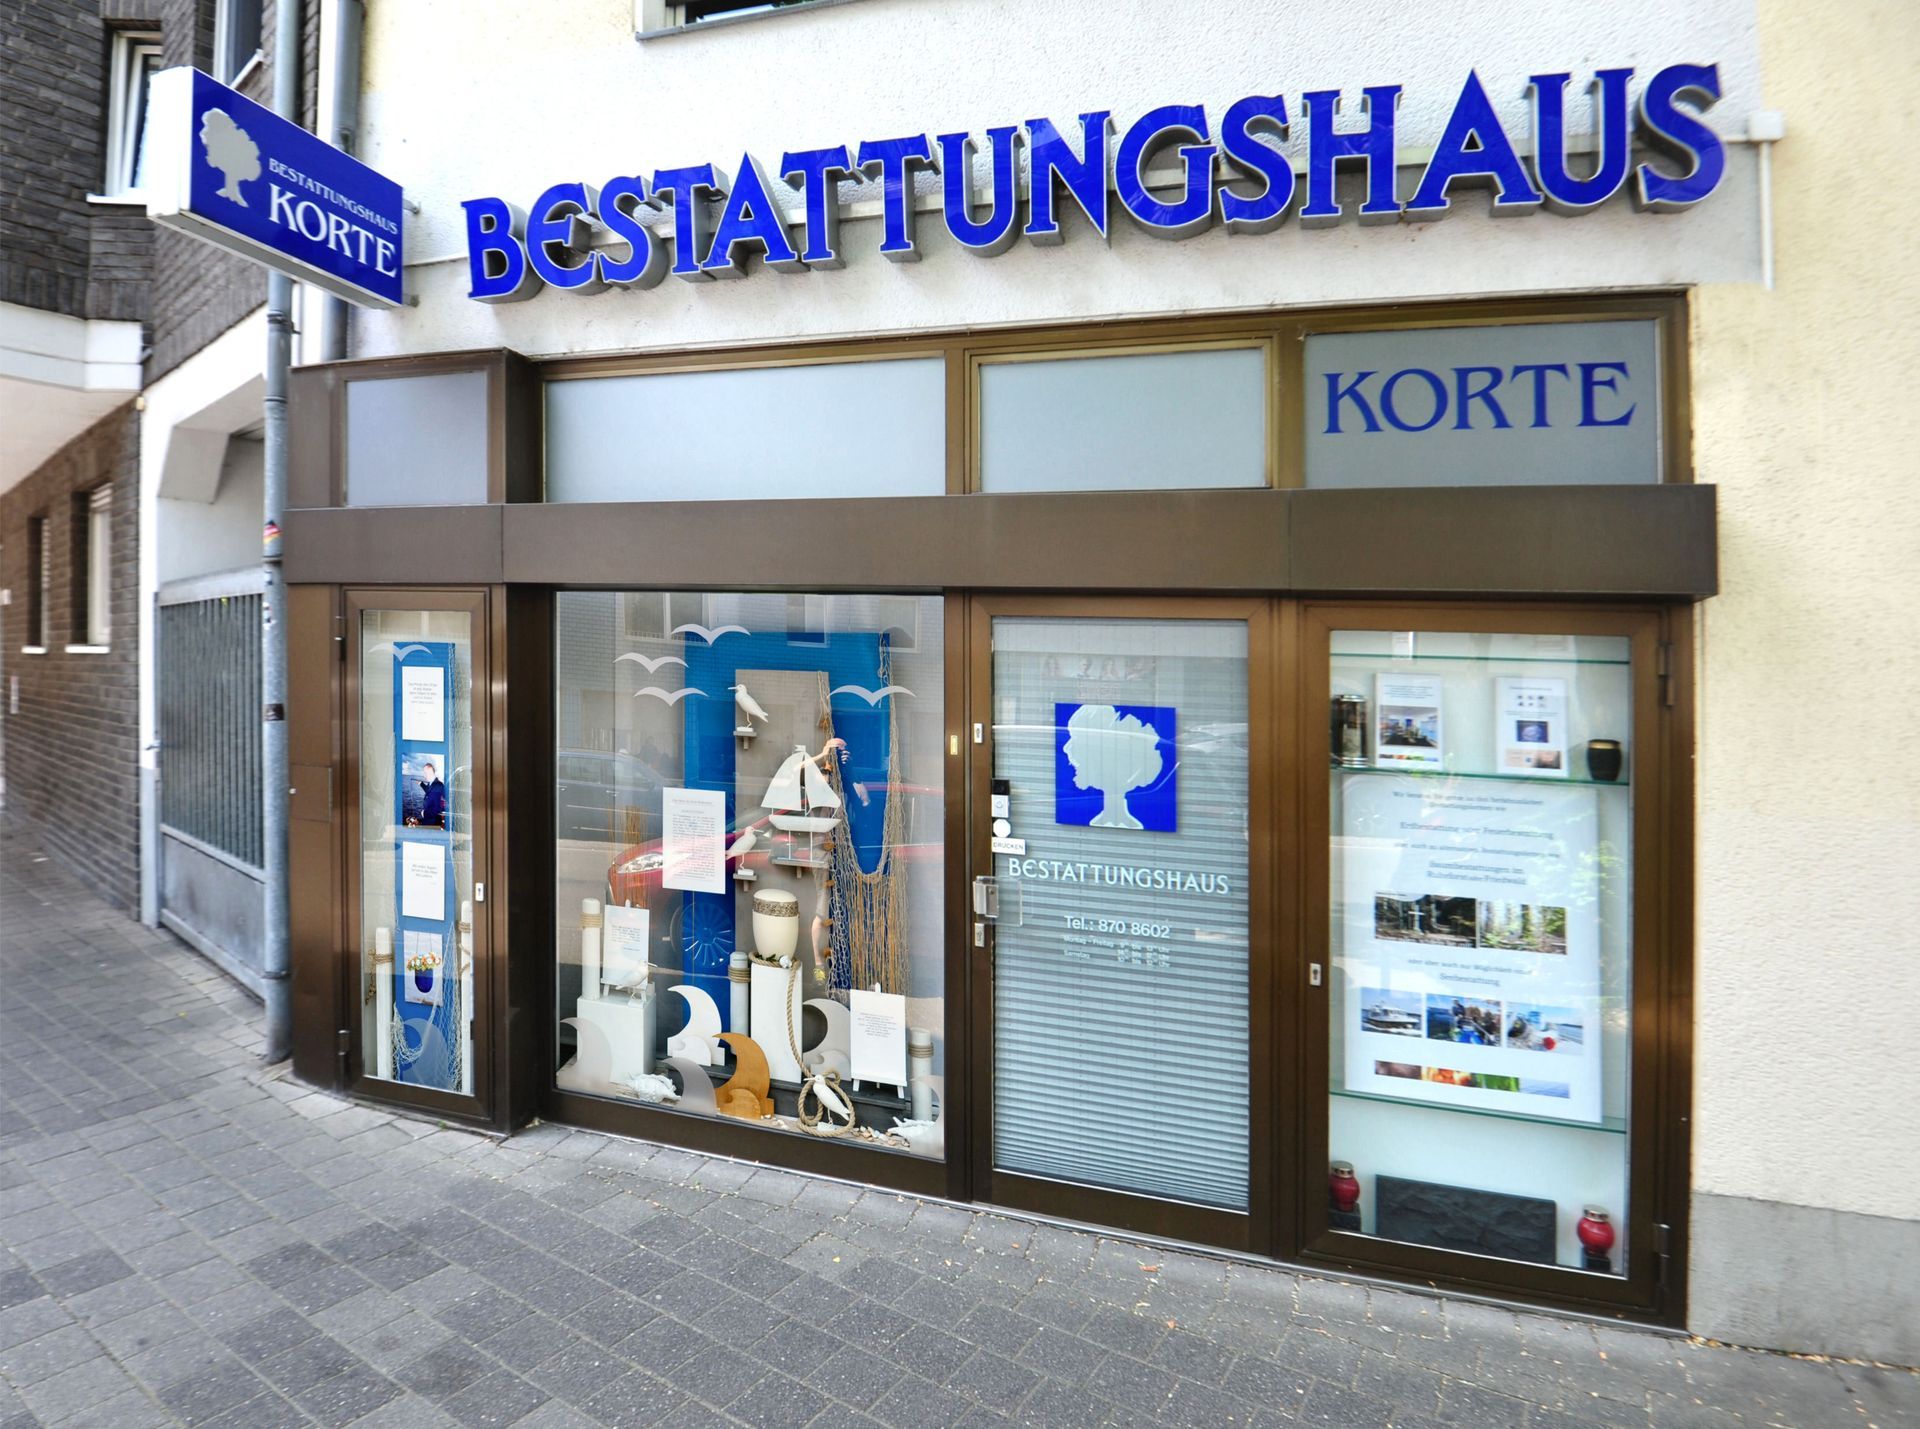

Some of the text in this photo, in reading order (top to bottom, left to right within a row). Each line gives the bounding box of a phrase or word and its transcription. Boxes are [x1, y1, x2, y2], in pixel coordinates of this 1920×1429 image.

[268, 157, 399, 235] BESTATTUNGSHAUS
[461, 62, 1724, 298] BESTATTUNGSHAUS
[268, 182, 398, 278] KORTE
[1322, 362, 1637, 433] KORTE
[1008, 858, 1229, 894] BESTATTUNGSHAUS
[1064, 915, 1171, 939] Tel.: 870 8602
